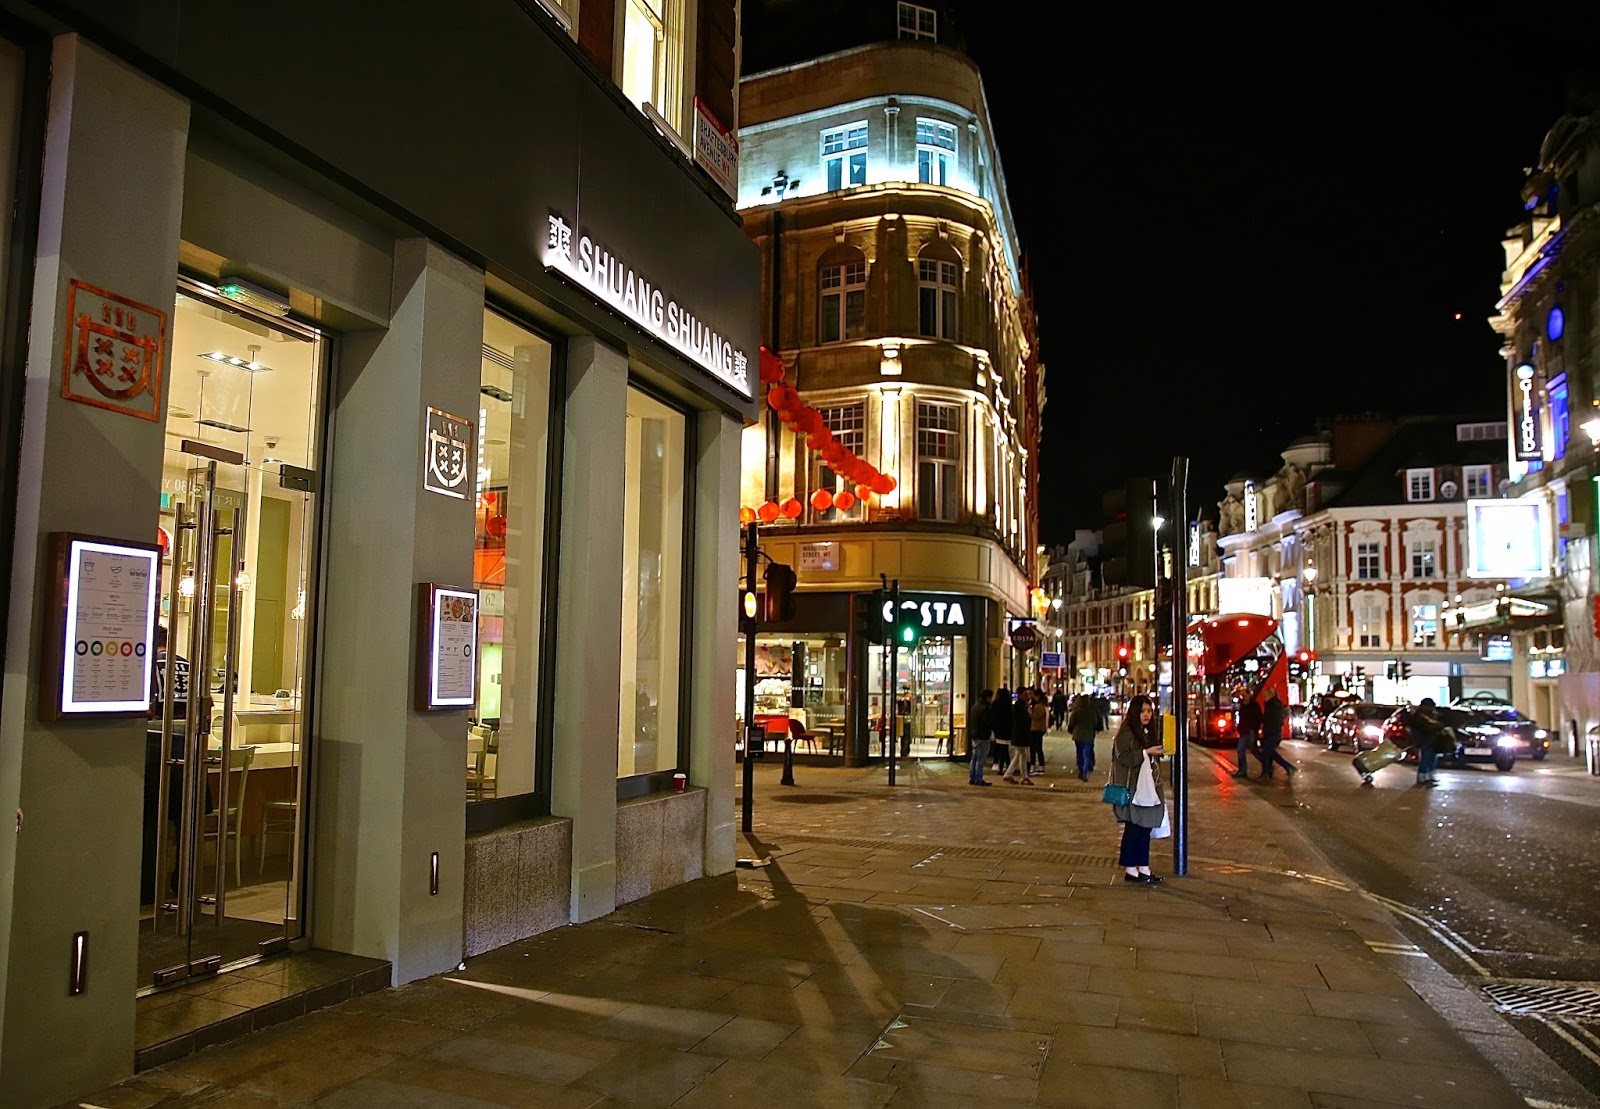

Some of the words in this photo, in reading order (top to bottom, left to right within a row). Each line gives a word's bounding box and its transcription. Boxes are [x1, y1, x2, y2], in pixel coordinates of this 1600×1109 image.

[700, 119, 736, 168] SHAFTESBURY
[700, 137, 720, 166] AVENUE
[578, 236, 664, 328] SHUANG
[667, 301, 733, 376] SHUANG
[1519, 378, 1536, 452] GIELGUD
[485, 593, 496, 606] 62
